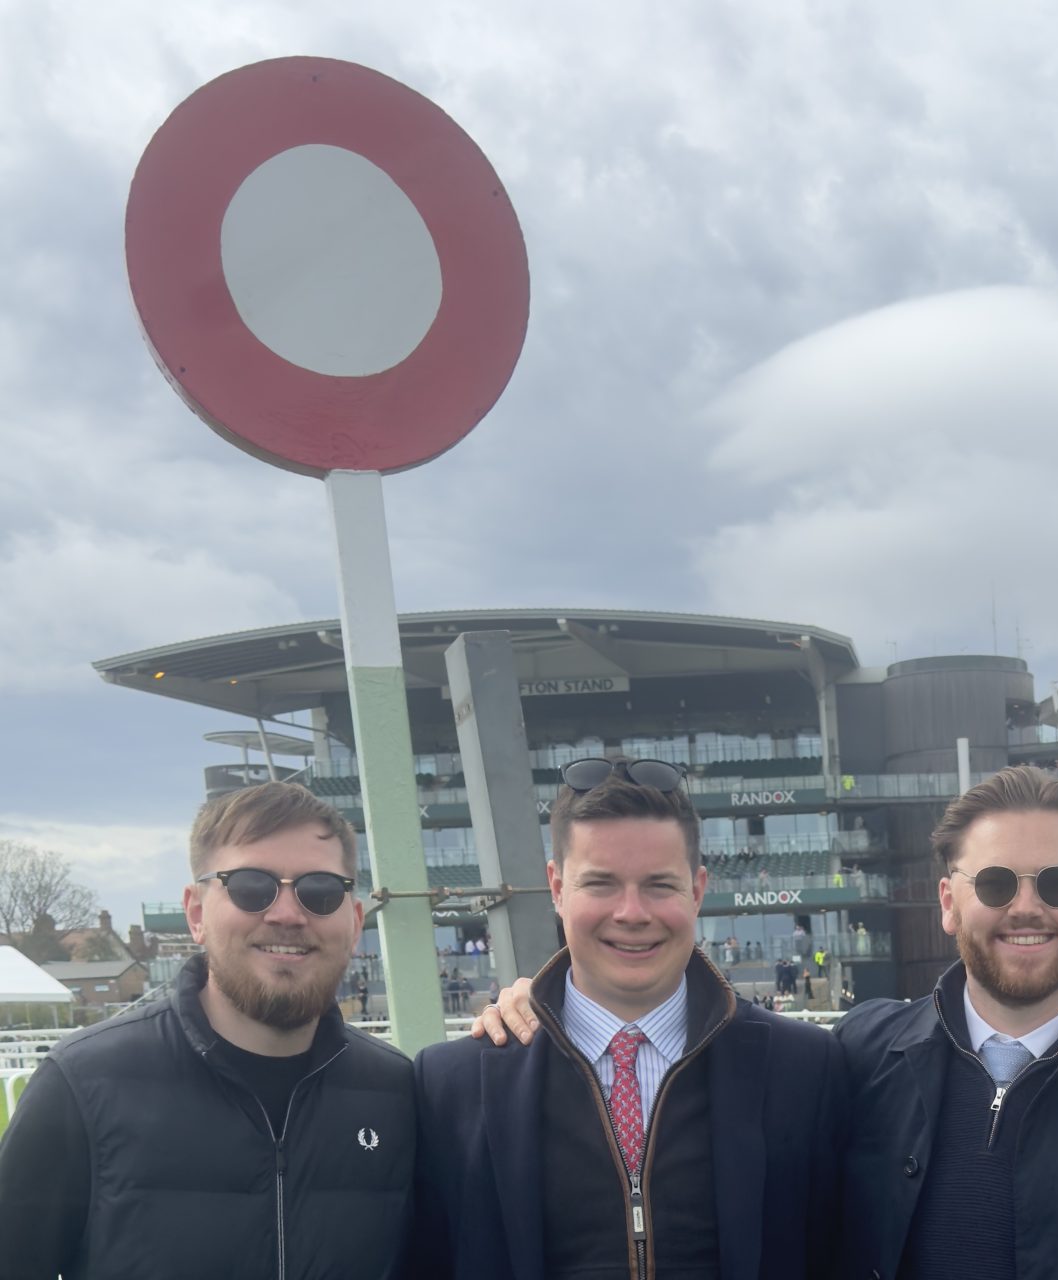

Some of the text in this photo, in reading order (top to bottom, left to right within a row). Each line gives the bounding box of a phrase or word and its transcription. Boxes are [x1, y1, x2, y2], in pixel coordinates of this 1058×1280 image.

[519, 678, 614, 694] FTON STAND
[731, 790, 796, 806] RANDOX
[734, 890, 802, 906] RANDOX
